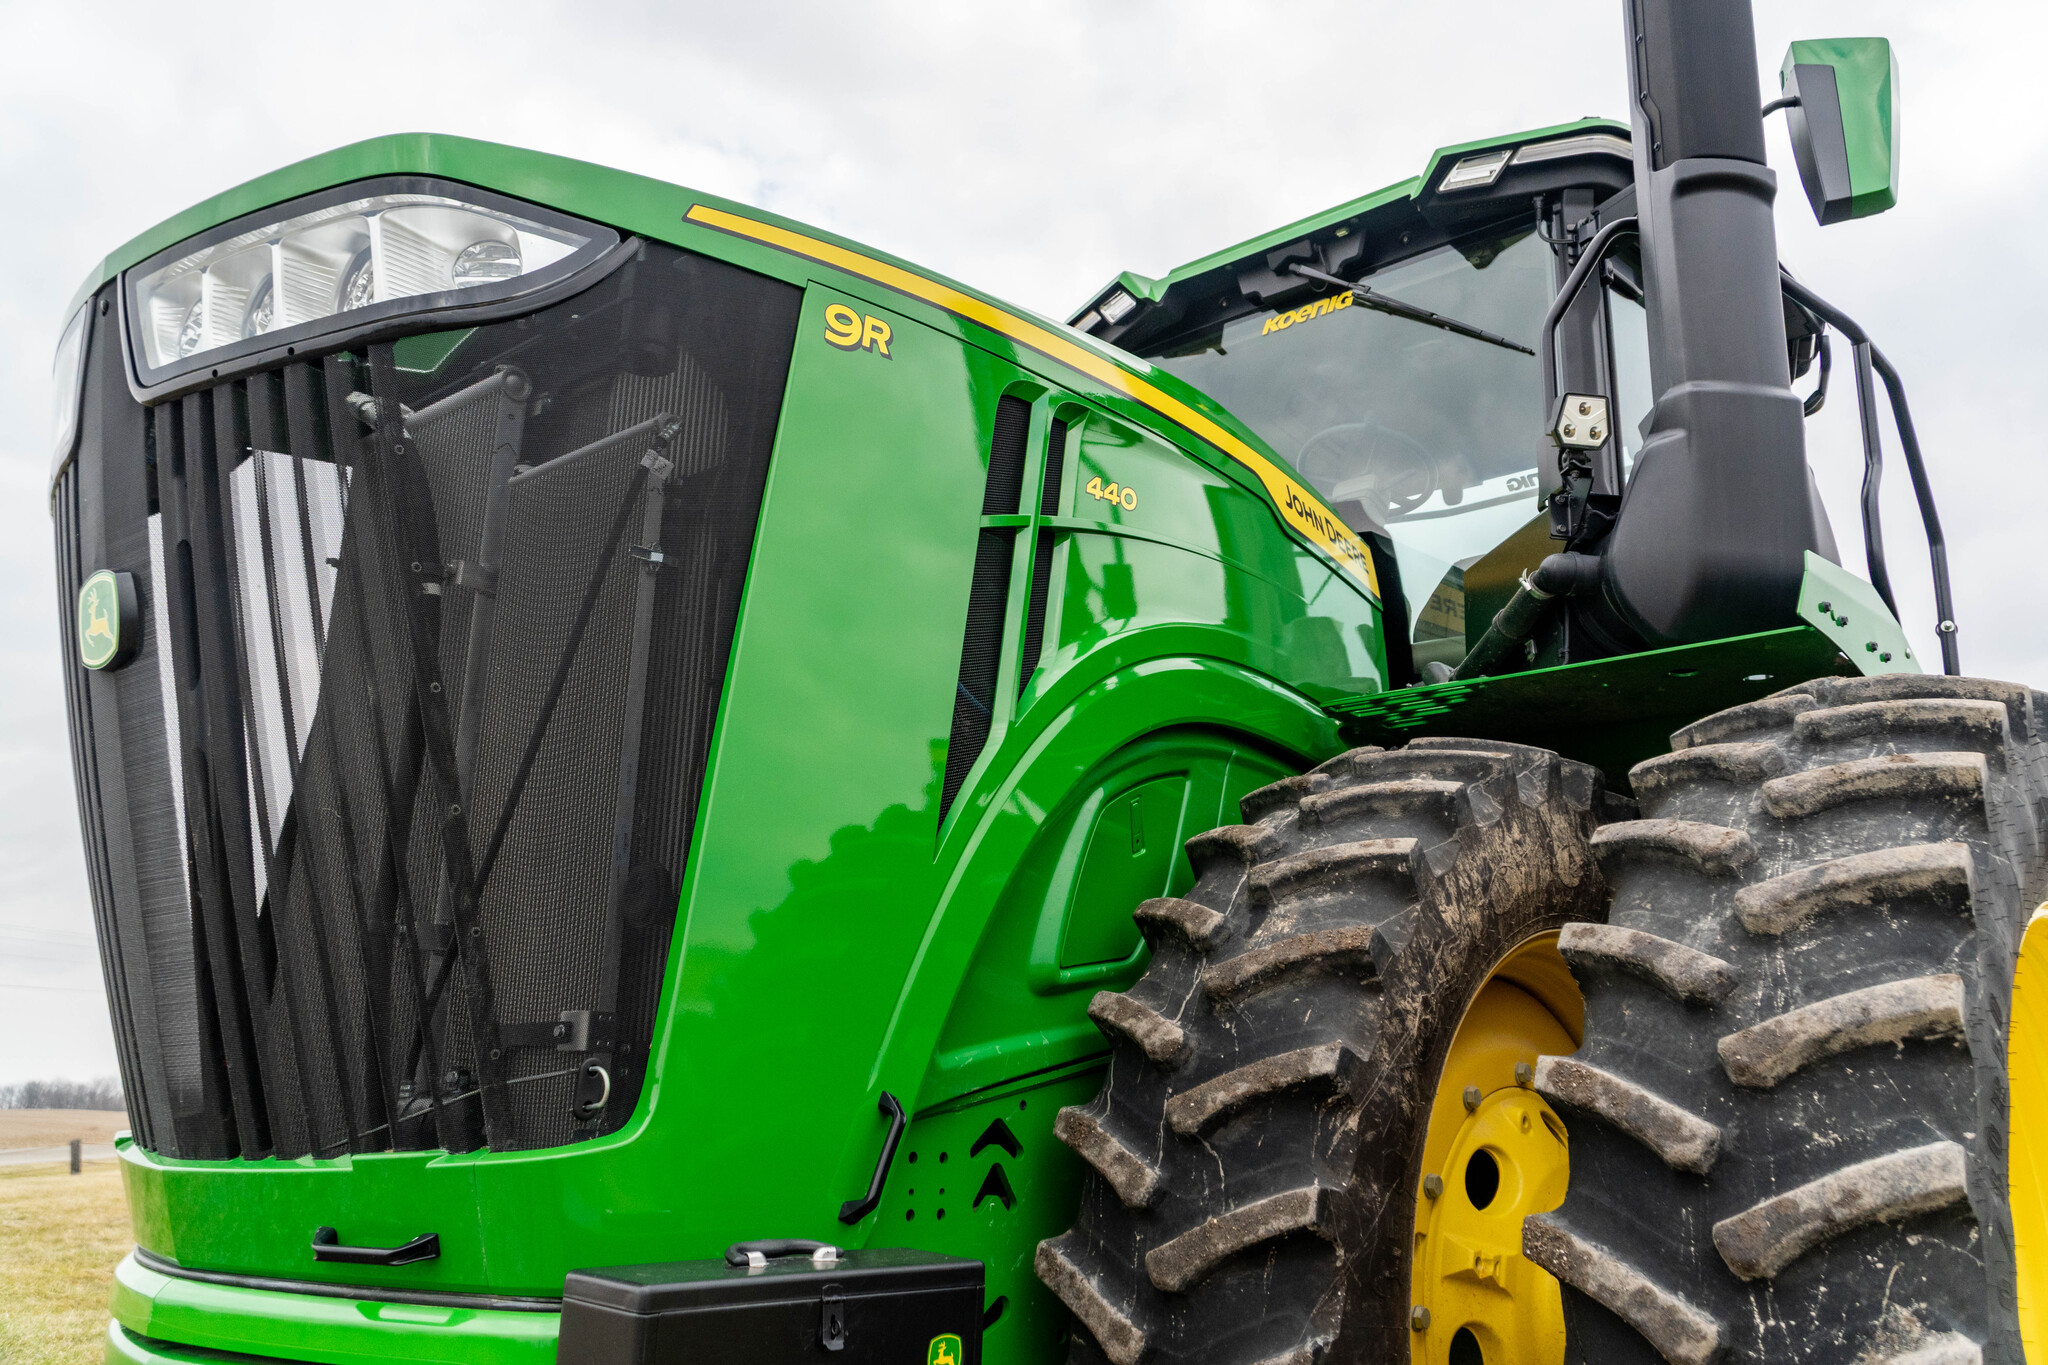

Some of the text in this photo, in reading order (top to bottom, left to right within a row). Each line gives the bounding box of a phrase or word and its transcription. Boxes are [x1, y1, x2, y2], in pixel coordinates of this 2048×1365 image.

[824, 303, 894, 361] 9R
[1086, 475, 1138, 512] 440
[1285, 484, 1369, 575] JOHN DEERE
